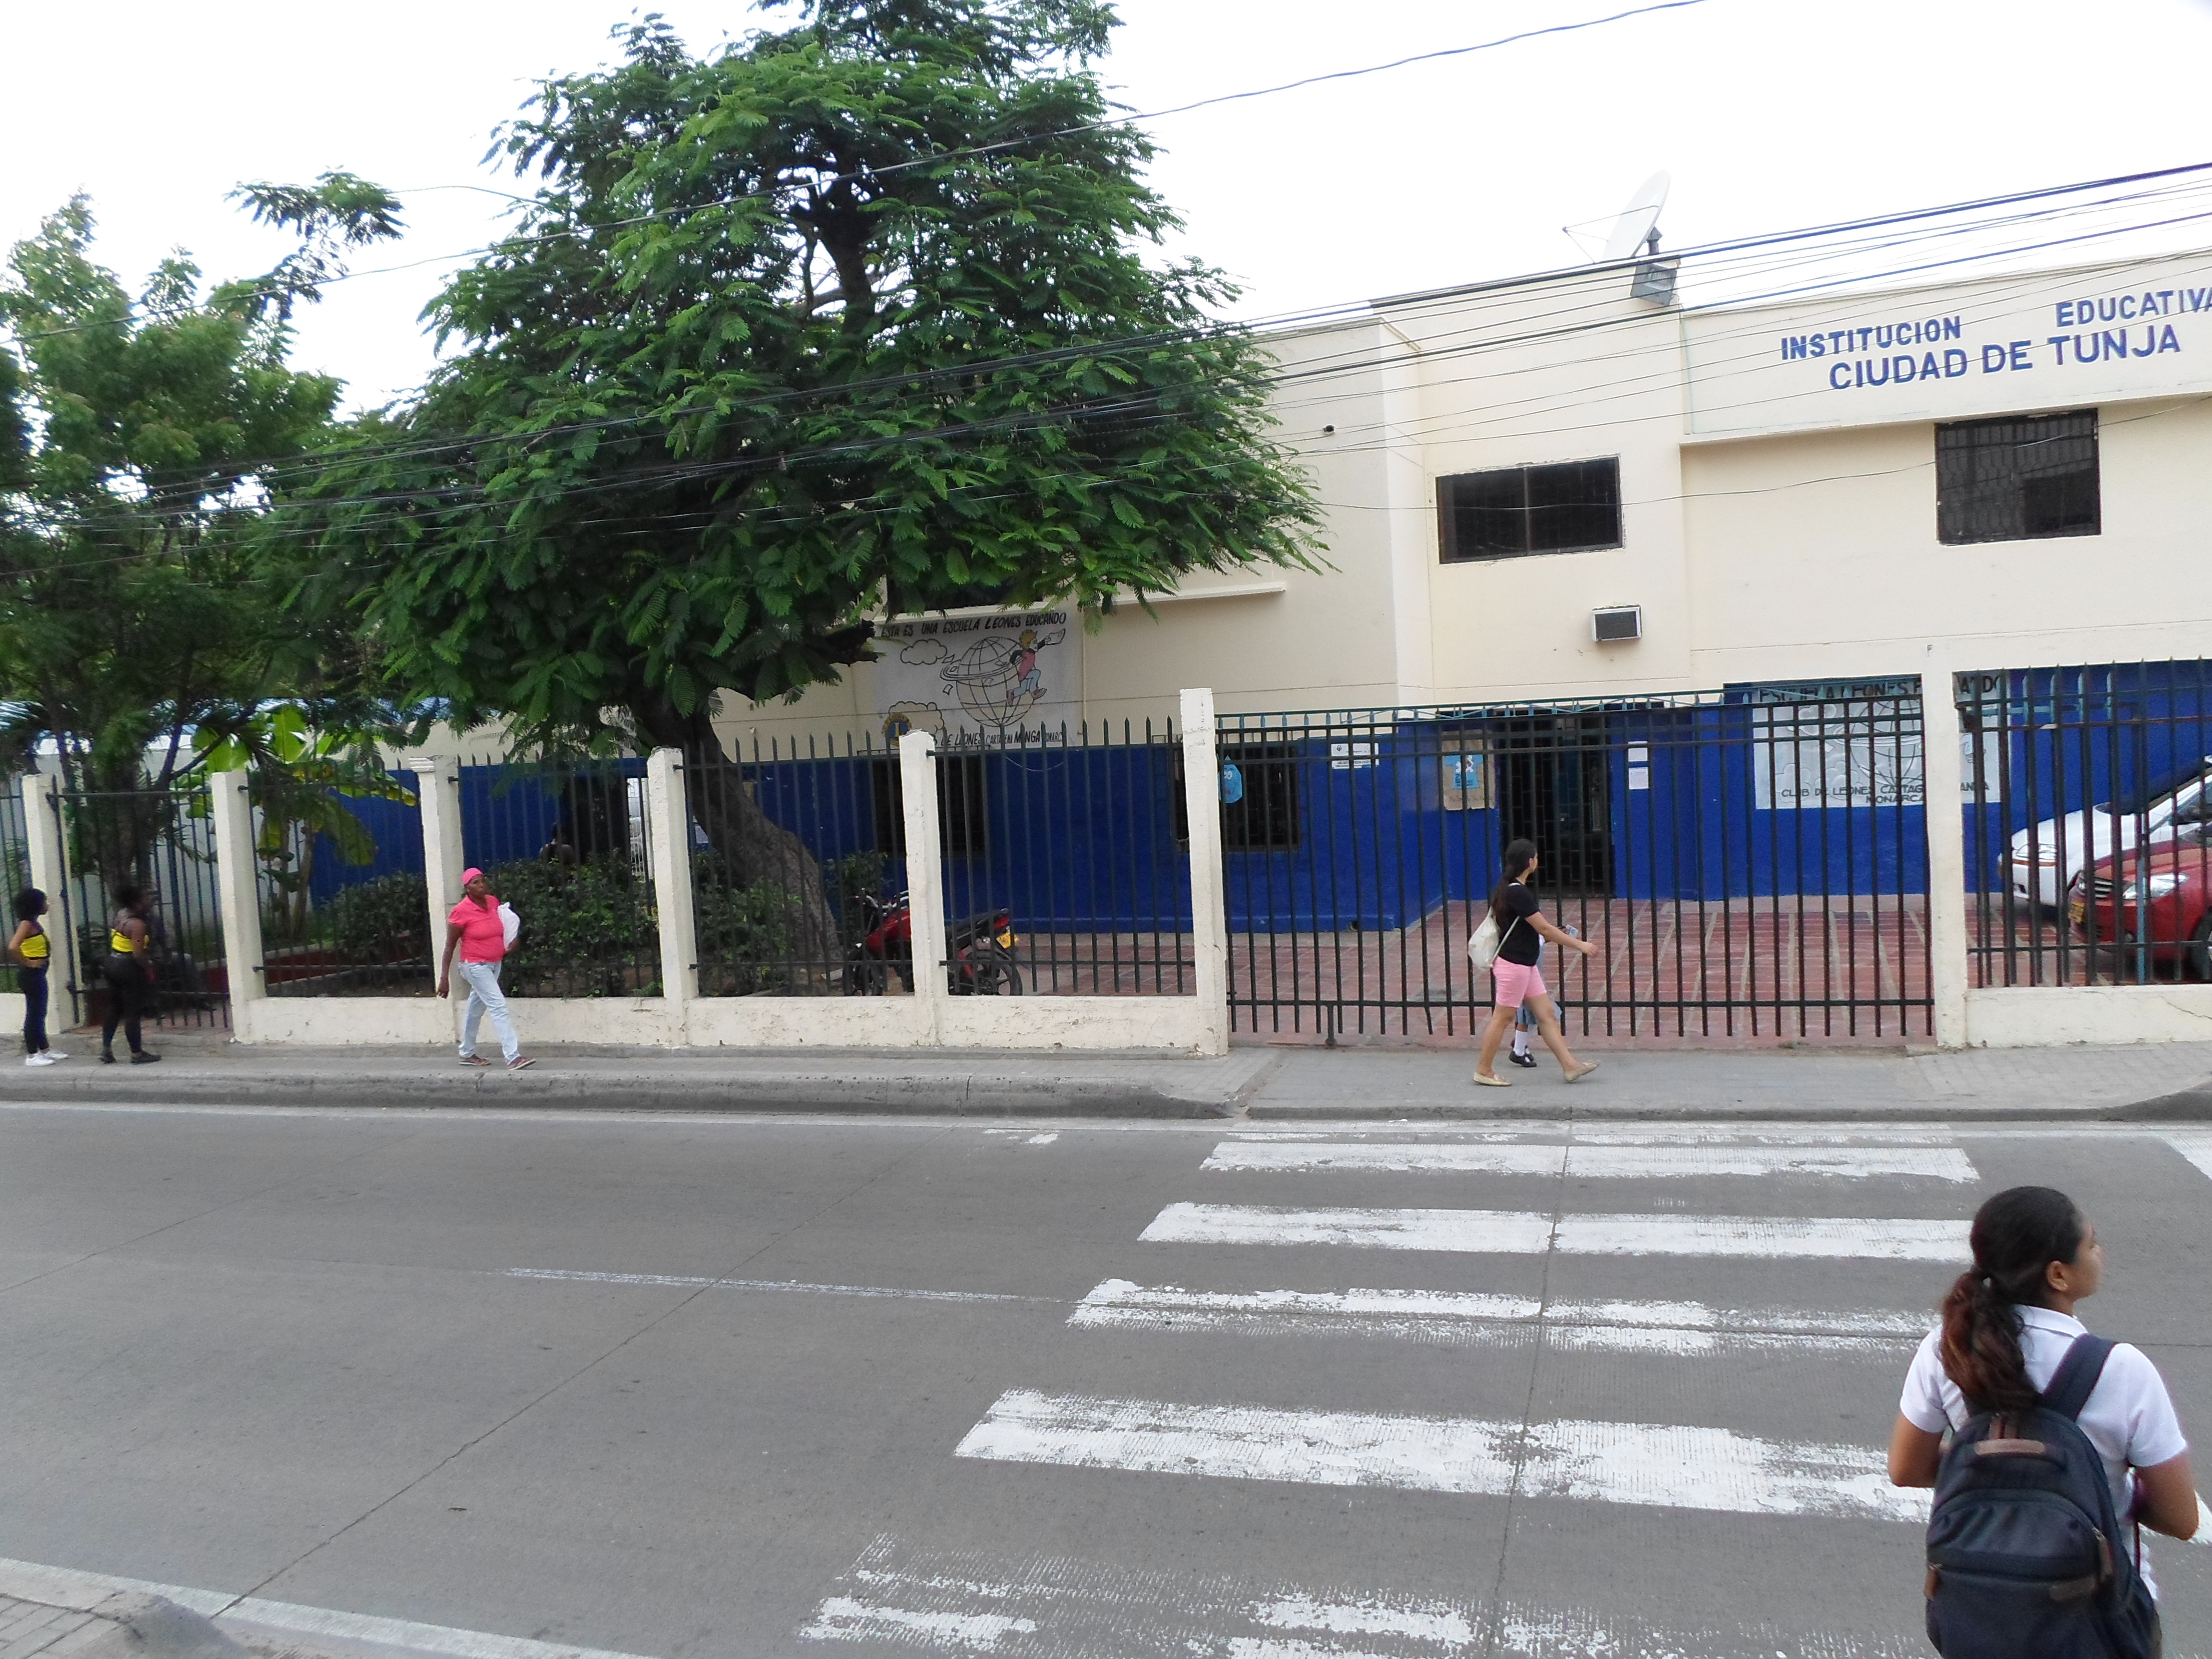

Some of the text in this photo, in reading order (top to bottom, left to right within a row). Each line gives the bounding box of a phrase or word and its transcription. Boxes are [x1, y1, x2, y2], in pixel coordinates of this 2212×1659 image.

[1781, 315, 1961, 360] INSTITUCION
[1829, 324, 2181, 389] CIUDAD DE TUNJA
[881, 612, 1067, 637] ESTA ES UNA ESCUELA LEONES EDUCANDO
[955, 733, 982, 745] LONES
[1014, 730, 1040, 743] MNGA
[1781, 788, 1810, 797] CLB
